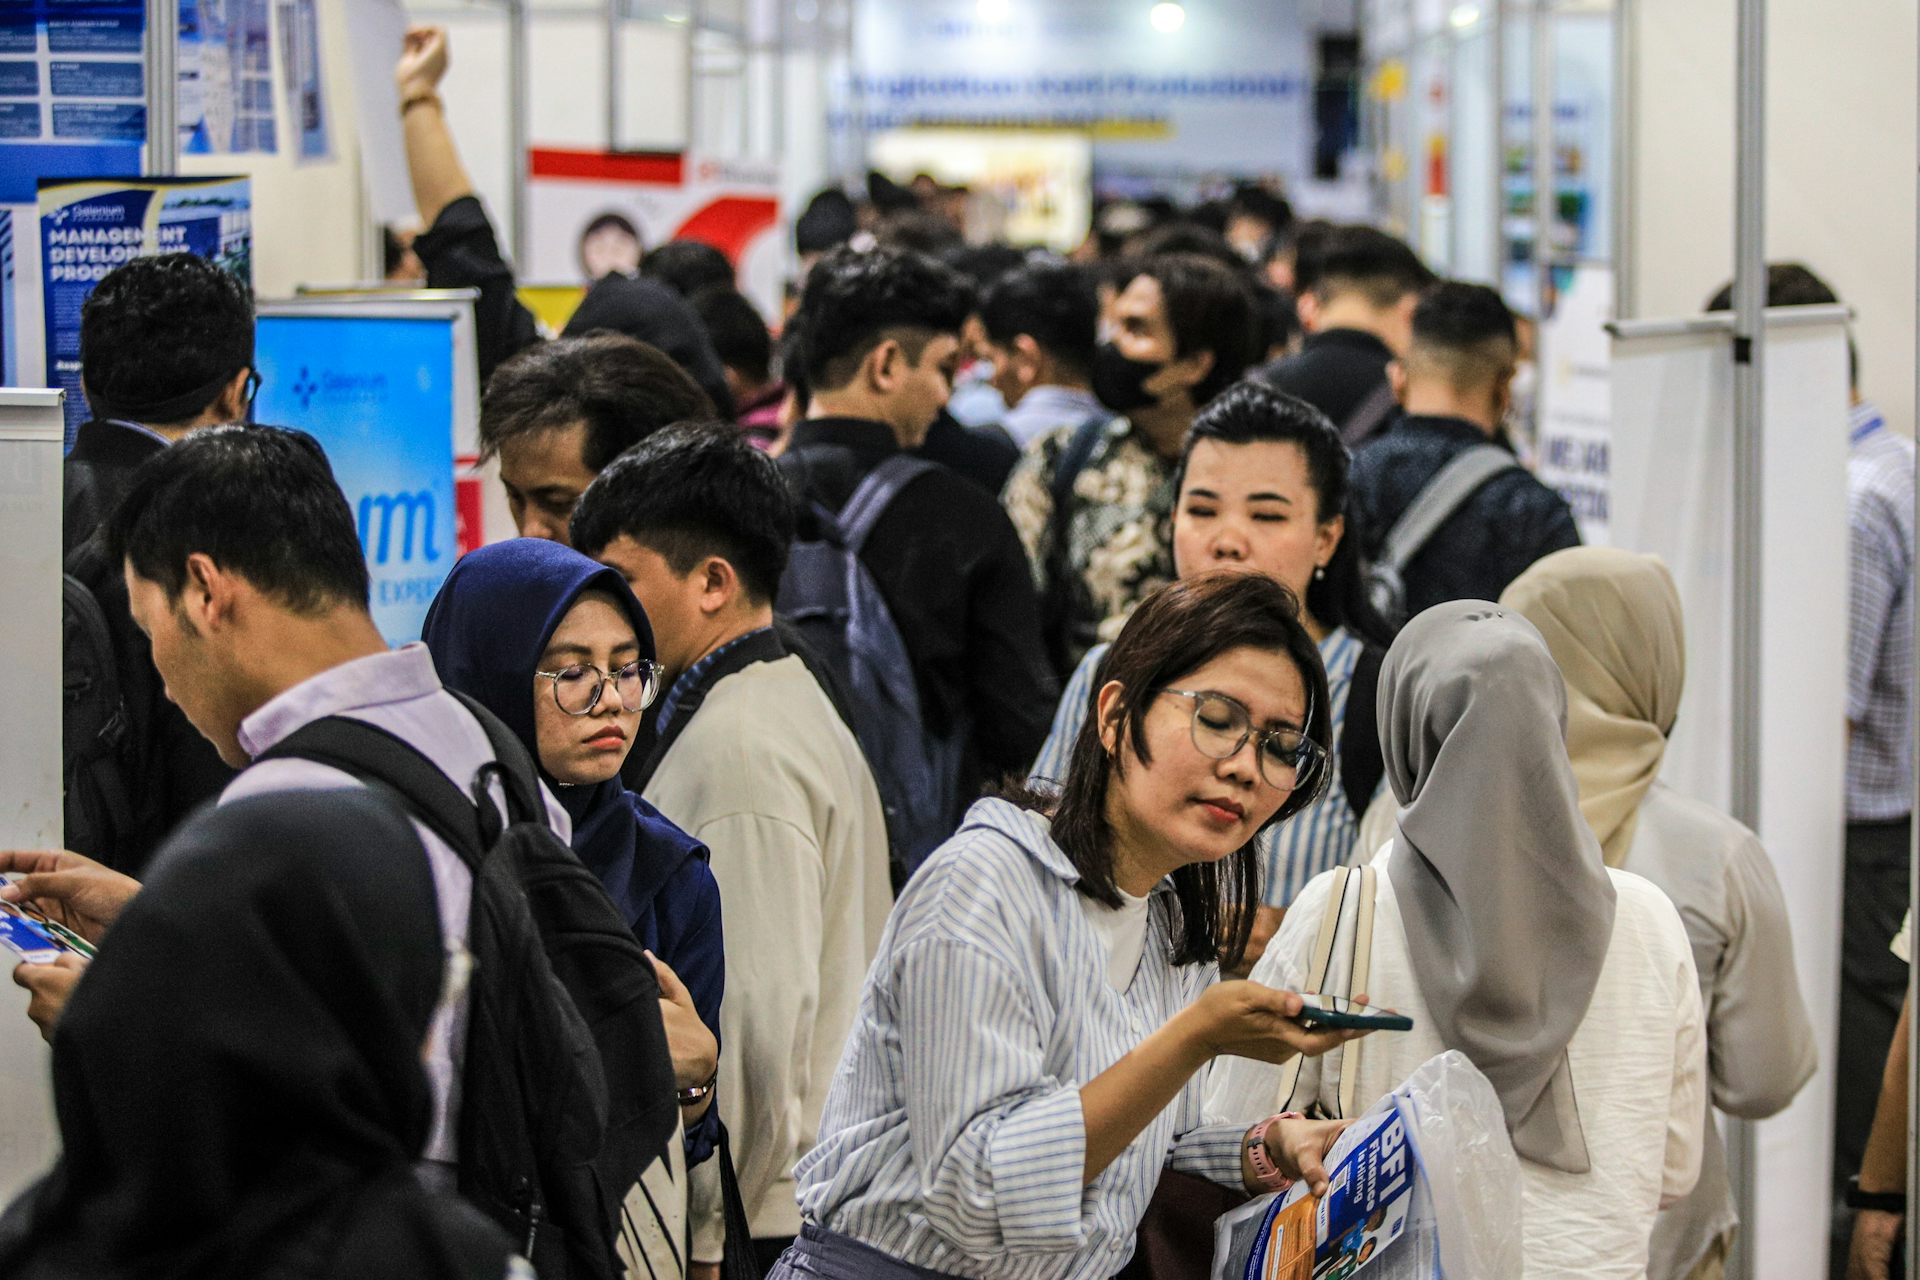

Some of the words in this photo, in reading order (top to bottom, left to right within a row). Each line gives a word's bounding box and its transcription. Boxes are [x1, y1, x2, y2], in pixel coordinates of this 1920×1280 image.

[1353, 1162, 1366, 1204] Hiring
[1366, 1138, 1380, 1212] Finance
[1379, 1116, 1406, 1202] BFI
